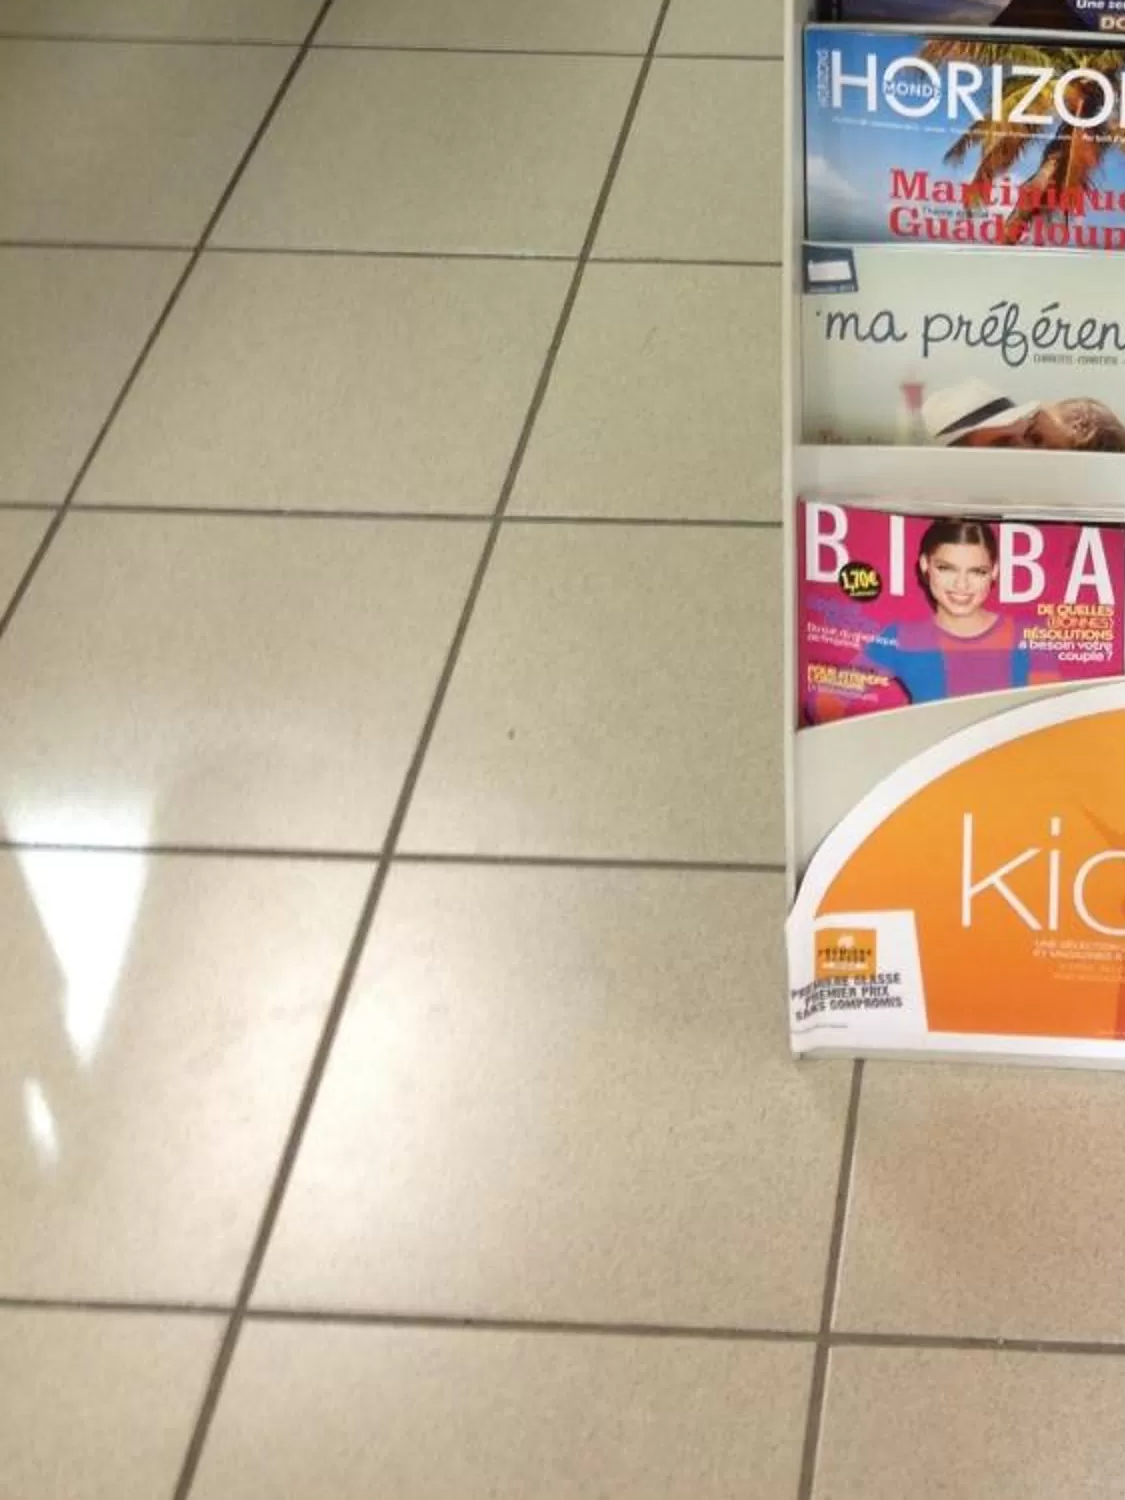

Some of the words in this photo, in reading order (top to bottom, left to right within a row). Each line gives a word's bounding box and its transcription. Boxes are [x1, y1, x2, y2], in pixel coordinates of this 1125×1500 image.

[824, 309, 908, 343] ma
[804, 502, 1115, 606] BIBA
[1037, 603, 1054, 616] DE
[1057, 604, 1114, 617] QUELLES
[1023, 625, 1114, 641] RÉSOLUTIONS
[1029, 639, 1075, 651] besoin
[1077, 641, 1114, 653] votre
[1057, 651, 1105, 663] couple
[861, 985, 890, 998] PRIX
